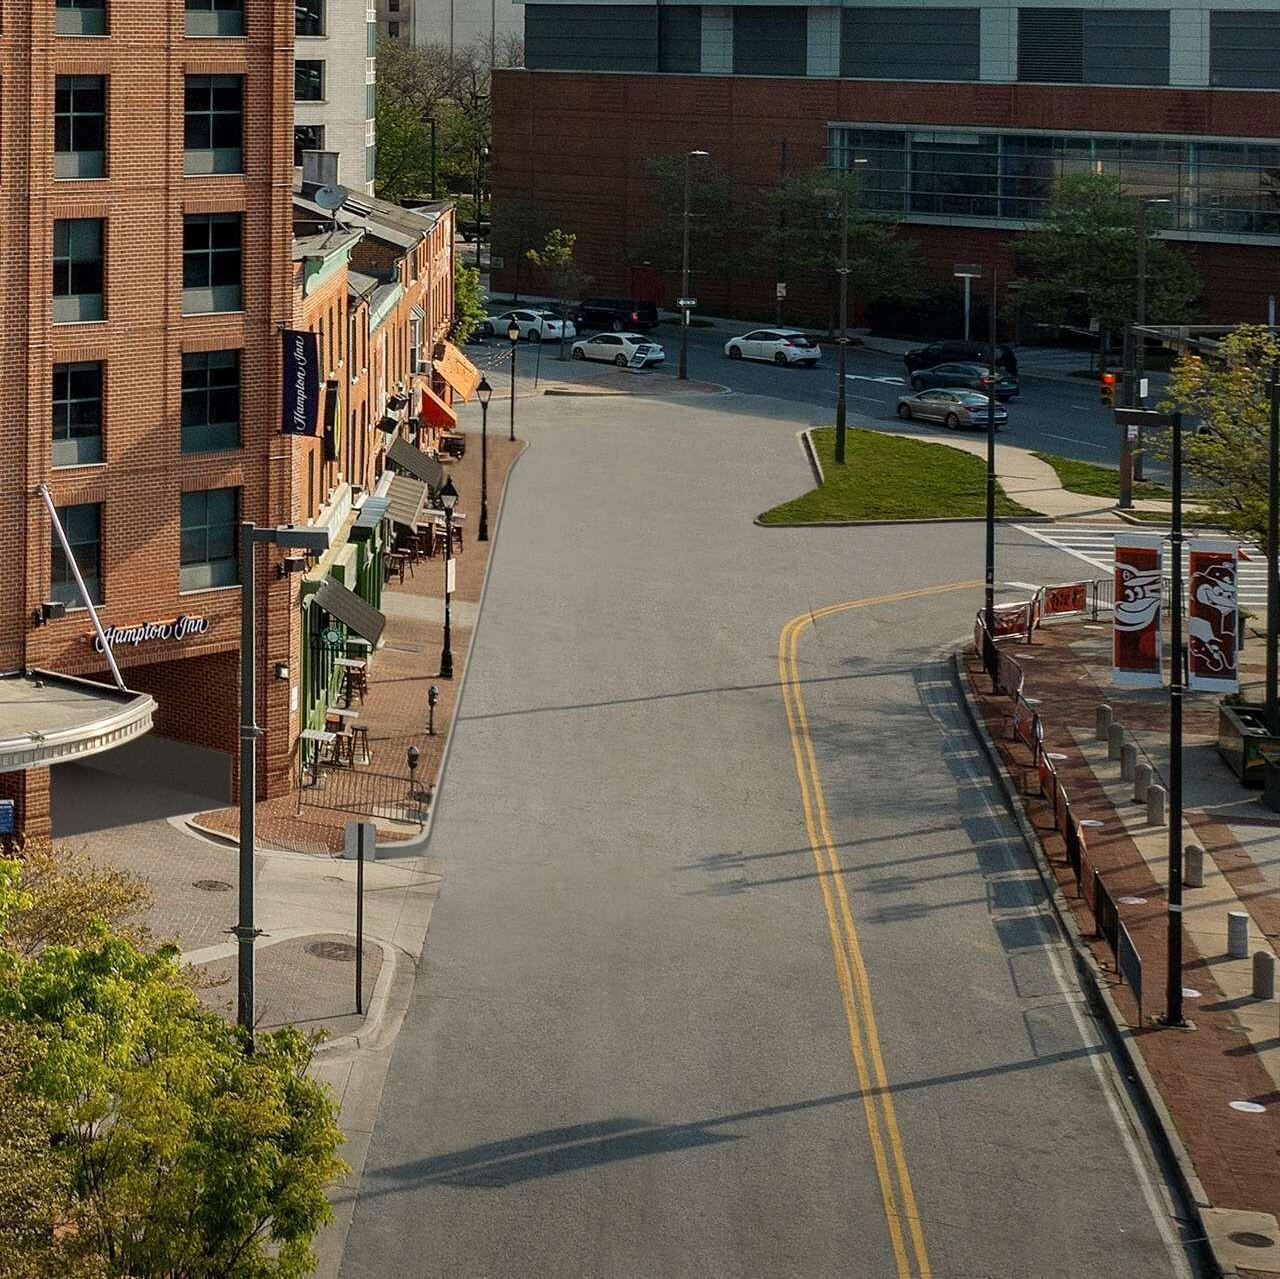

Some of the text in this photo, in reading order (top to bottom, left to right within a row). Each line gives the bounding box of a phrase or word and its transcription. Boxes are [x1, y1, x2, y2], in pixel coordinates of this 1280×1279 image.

[292, 335, 308, 431] Hampton Inn
[95, 615, 210, 653] Hampton Inn
